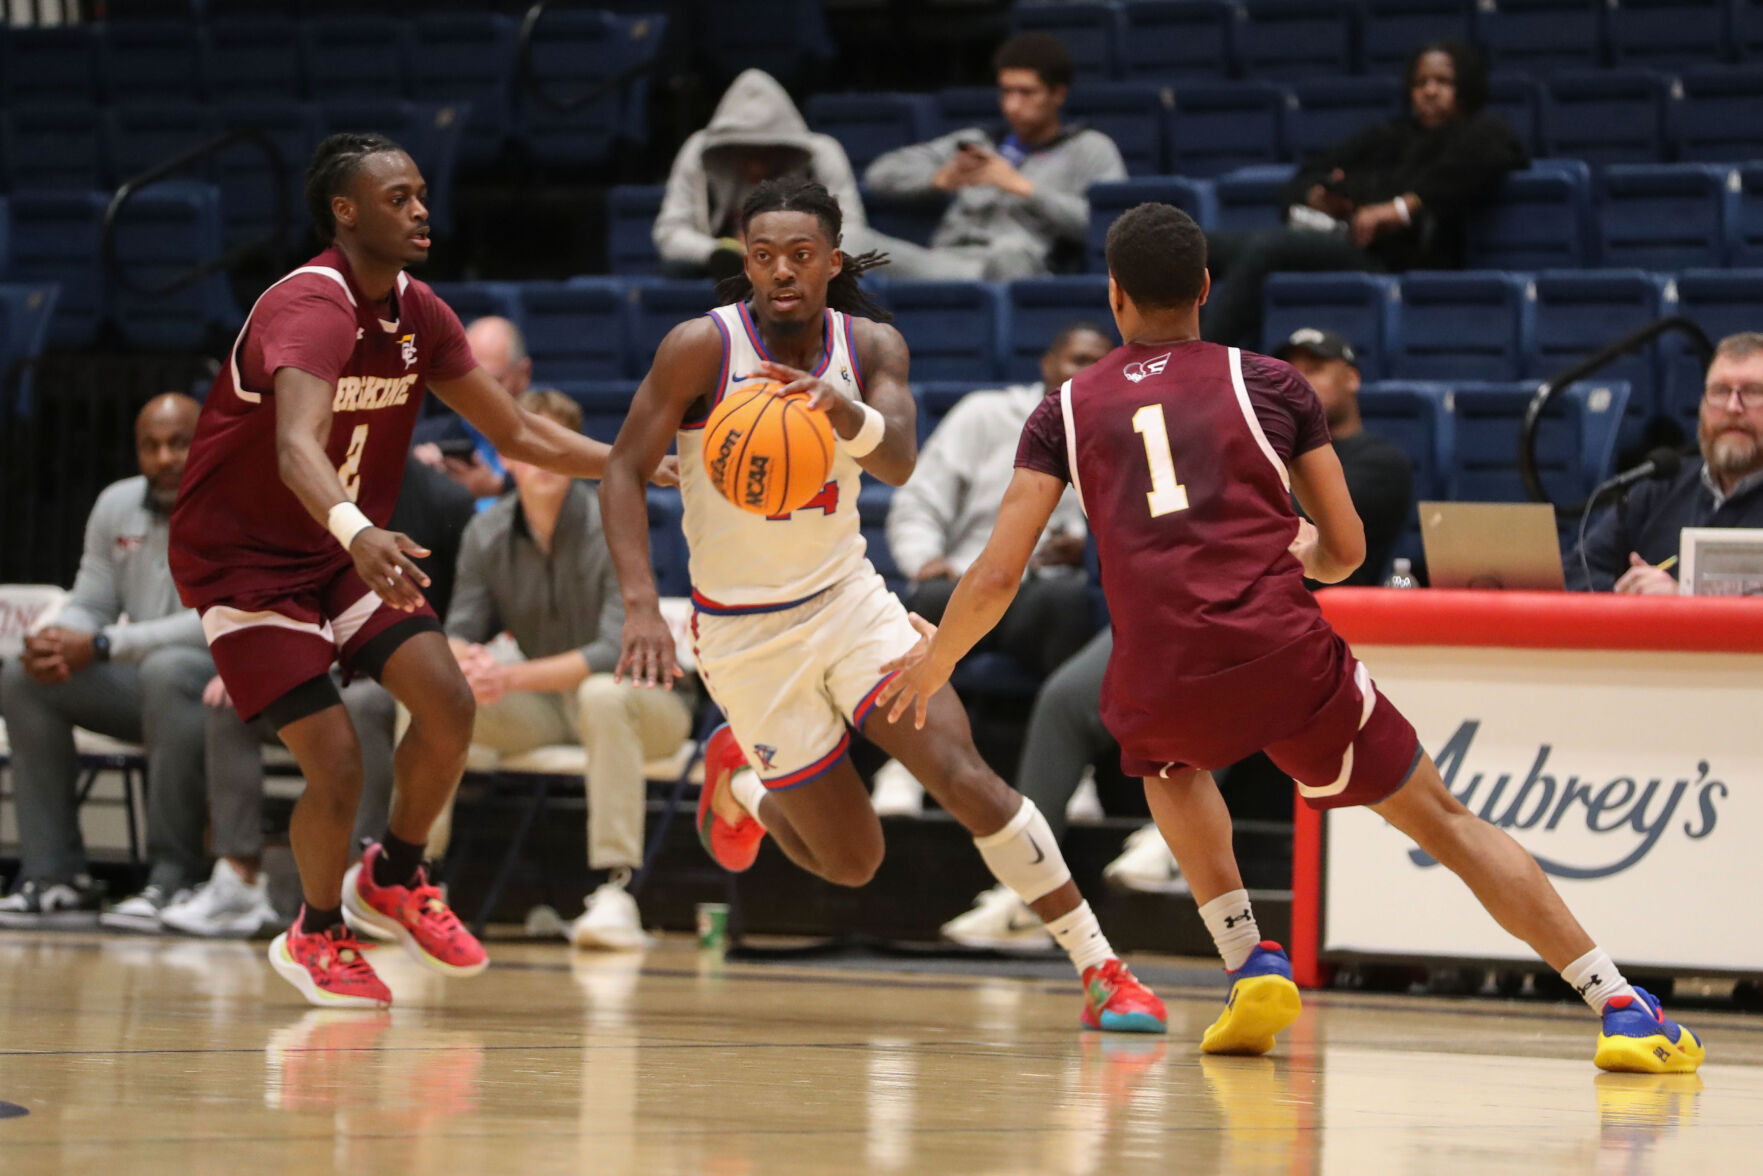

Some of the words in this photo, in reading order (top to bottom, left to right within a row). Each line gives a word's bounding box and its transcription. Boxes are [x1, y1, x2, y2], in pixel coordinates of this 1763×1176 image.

[332, 373, 419, 413] ERKINE
[337, 423, 369, 503] 2
[744, 455, 769, 508] NCAA
[1131, 403, 1190, 518] 1
[1407, 719, 1728, 879] Aubrey's
